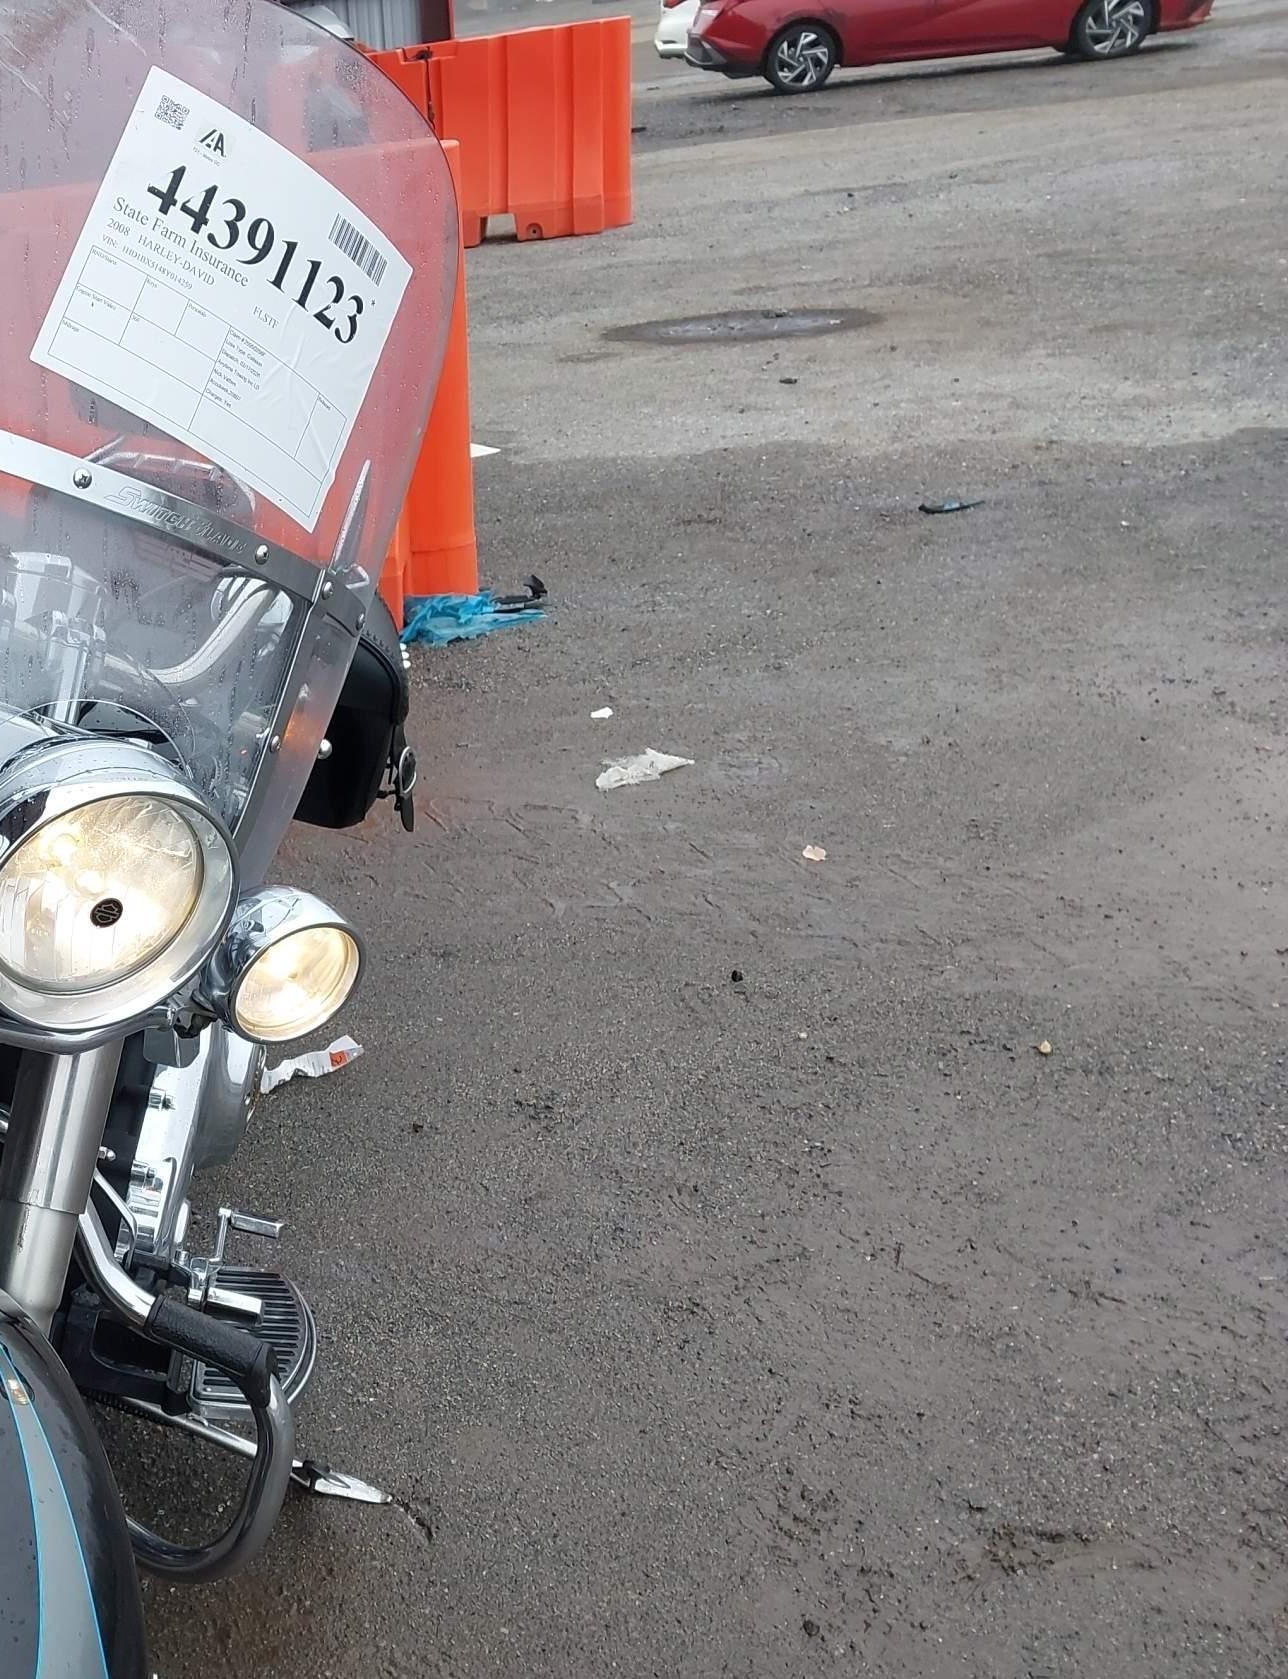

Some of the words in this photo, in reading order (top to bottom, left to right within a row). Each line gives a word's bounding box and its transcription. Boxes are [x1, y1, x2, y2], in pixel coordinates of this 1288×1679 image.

[103, 235, 119, 249] VIN:
[107, 218, 130, 237] 2008
[138, 235, 215, 286] HARLEY-DAVID
[253, 306, 279, 329] FLSTF
[113, 197, 149, 226] State
[151, 218, 187, 249] Farm
[190, 240, 249, 287] Insurance
[147, 165, 364, 344] 44391123
